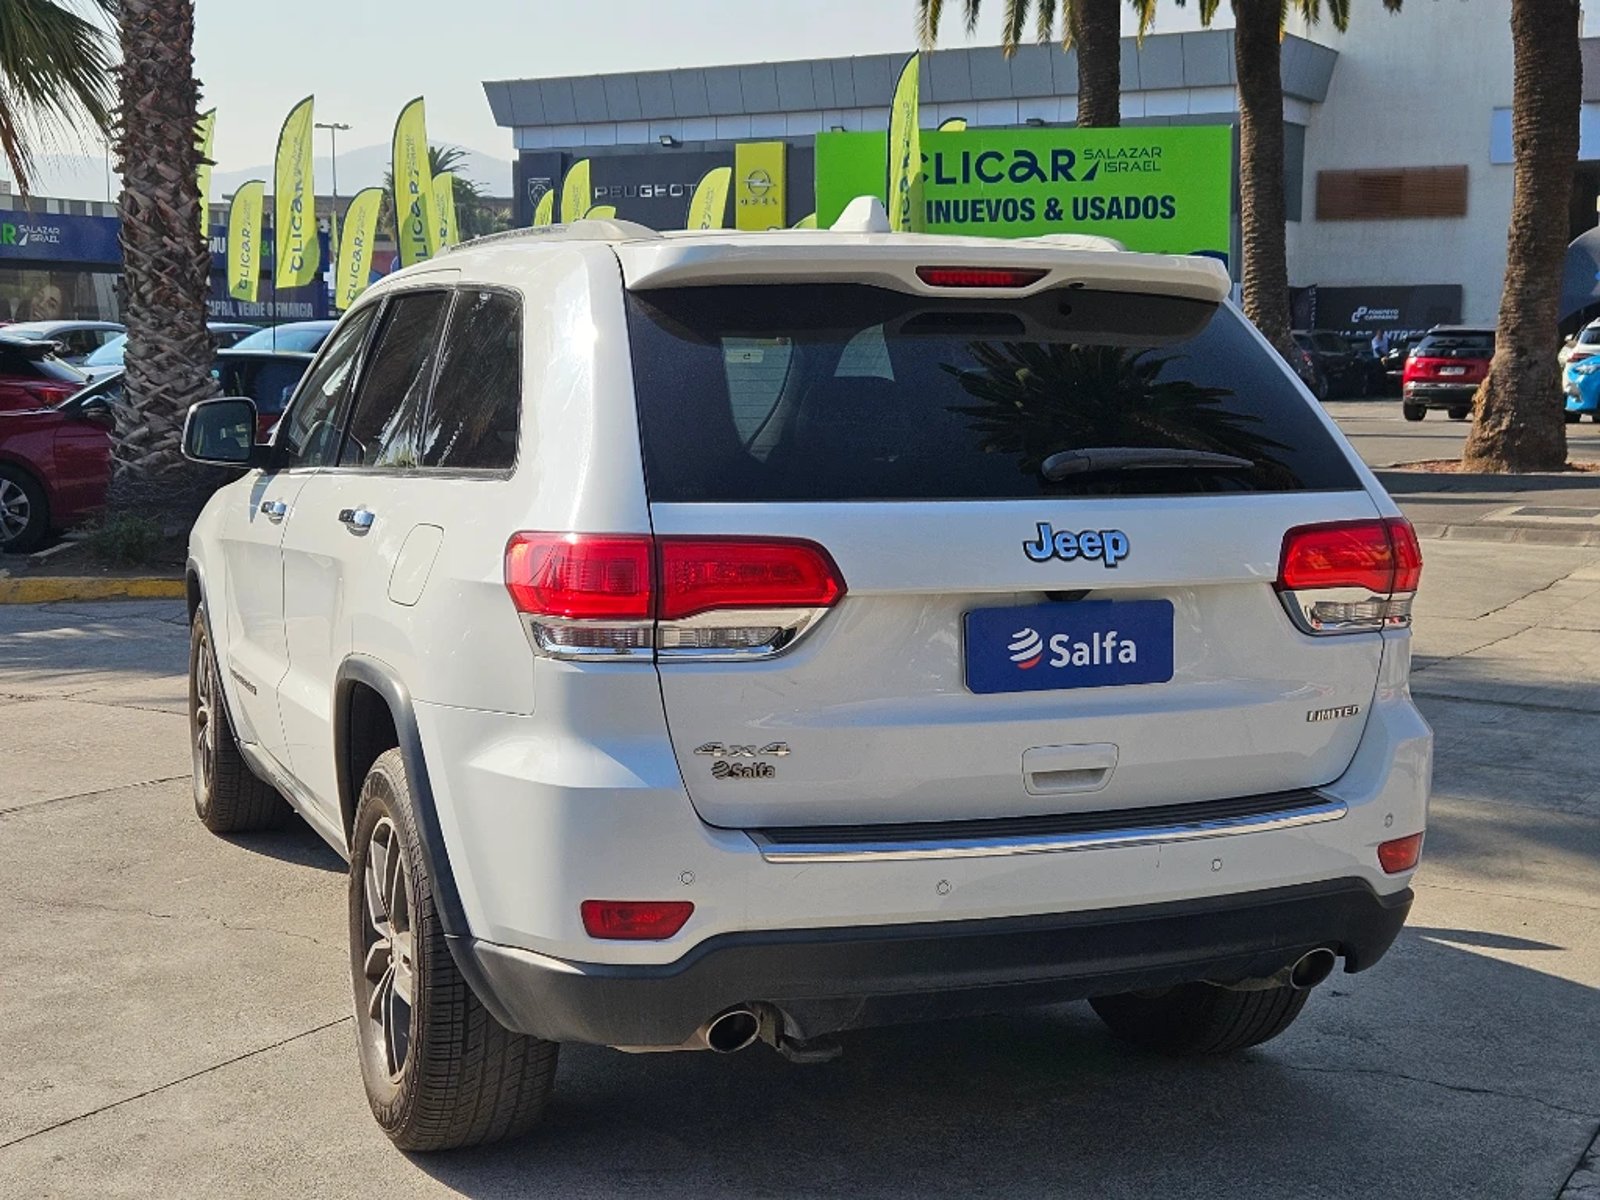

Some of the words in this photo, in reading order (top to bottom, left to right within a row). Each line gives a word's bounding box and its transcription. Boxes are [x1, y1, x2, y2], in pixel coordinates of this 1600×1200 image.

[1083, 147, 1162, 160] SALAZAR
[1104, 161, 1162, 173] ISRAEL
[926, 198, 1036, 224] INUEVOS
[1044, 197, 1063, 222] &
[1072, 194, 1176, 221] USADOS
[19, 224, 60, 234] SALAZAR
[1023, 522, 1129, 567] Jeep
[1050, 631, 1136, 667] Salfa
[1307, 704, 1360, 722] LIMITED
[730, 762, 775, 779] Salfa
